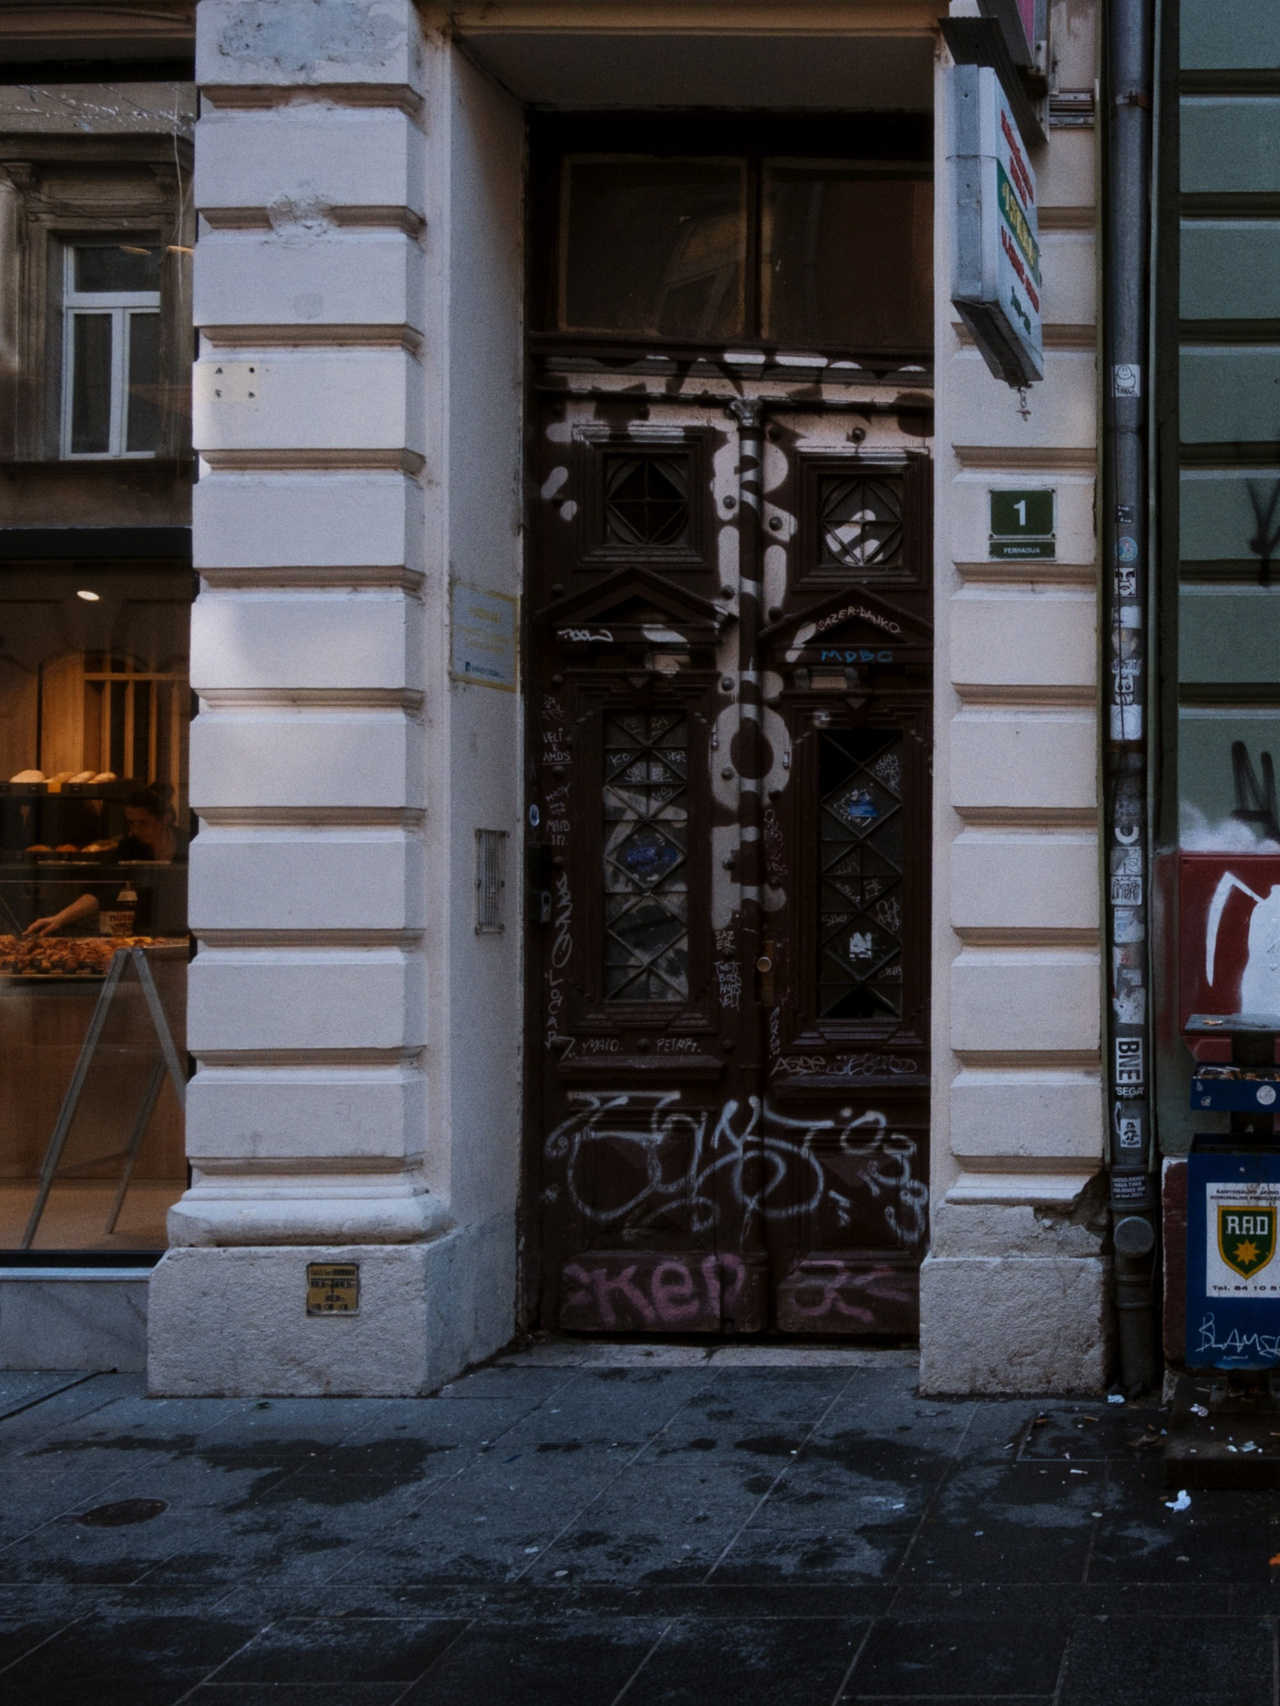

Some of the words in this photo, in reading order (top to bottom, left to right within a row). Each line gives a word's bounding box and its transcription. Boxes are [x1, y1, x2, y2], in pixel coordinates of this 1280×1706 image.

[1013, 500, 1026, 526] 1
[1117, 1040, 1141, 1082] BNE
[1225, 1216, 1269, 1236] RAD
